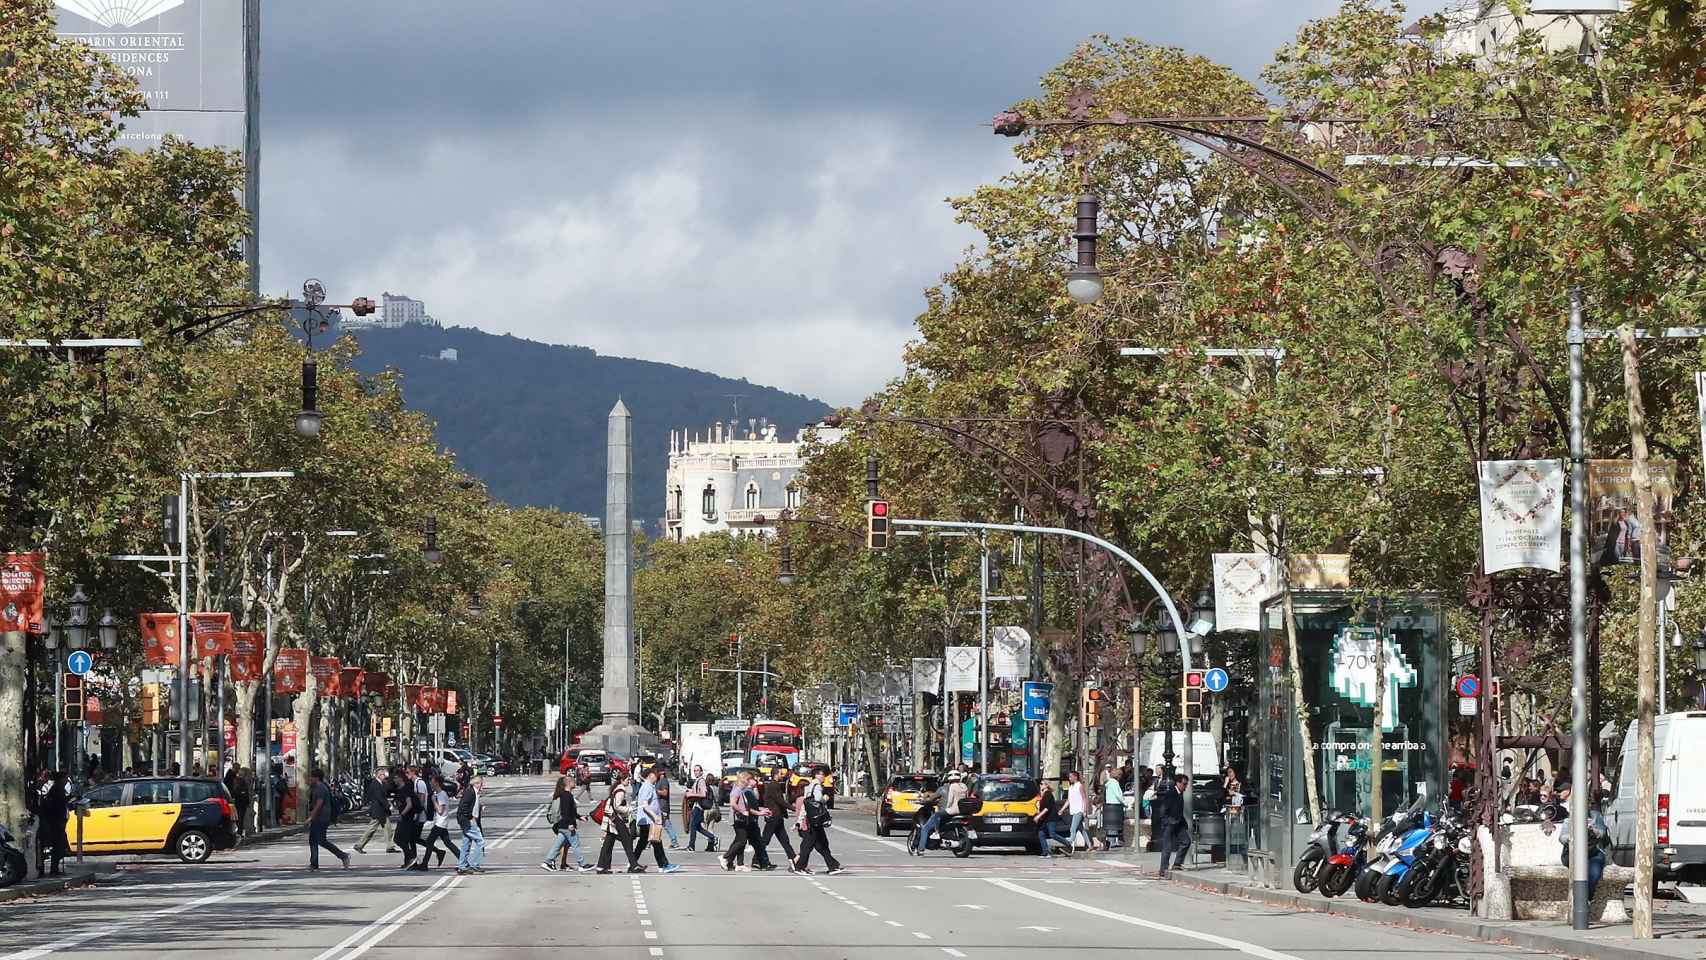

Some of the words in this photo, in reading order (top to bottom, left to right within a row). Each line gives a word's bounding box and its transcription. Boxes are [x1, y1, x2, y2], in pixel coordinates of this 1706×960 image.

[120, 36, 184, 47] ORIENTAL
[1321, 742, 1356, 752] compra
[1357, 742, 1390, 750] on-ne
[1391, 741, 1419, 750] arriba
[1420, 742, 1427, 750] a
